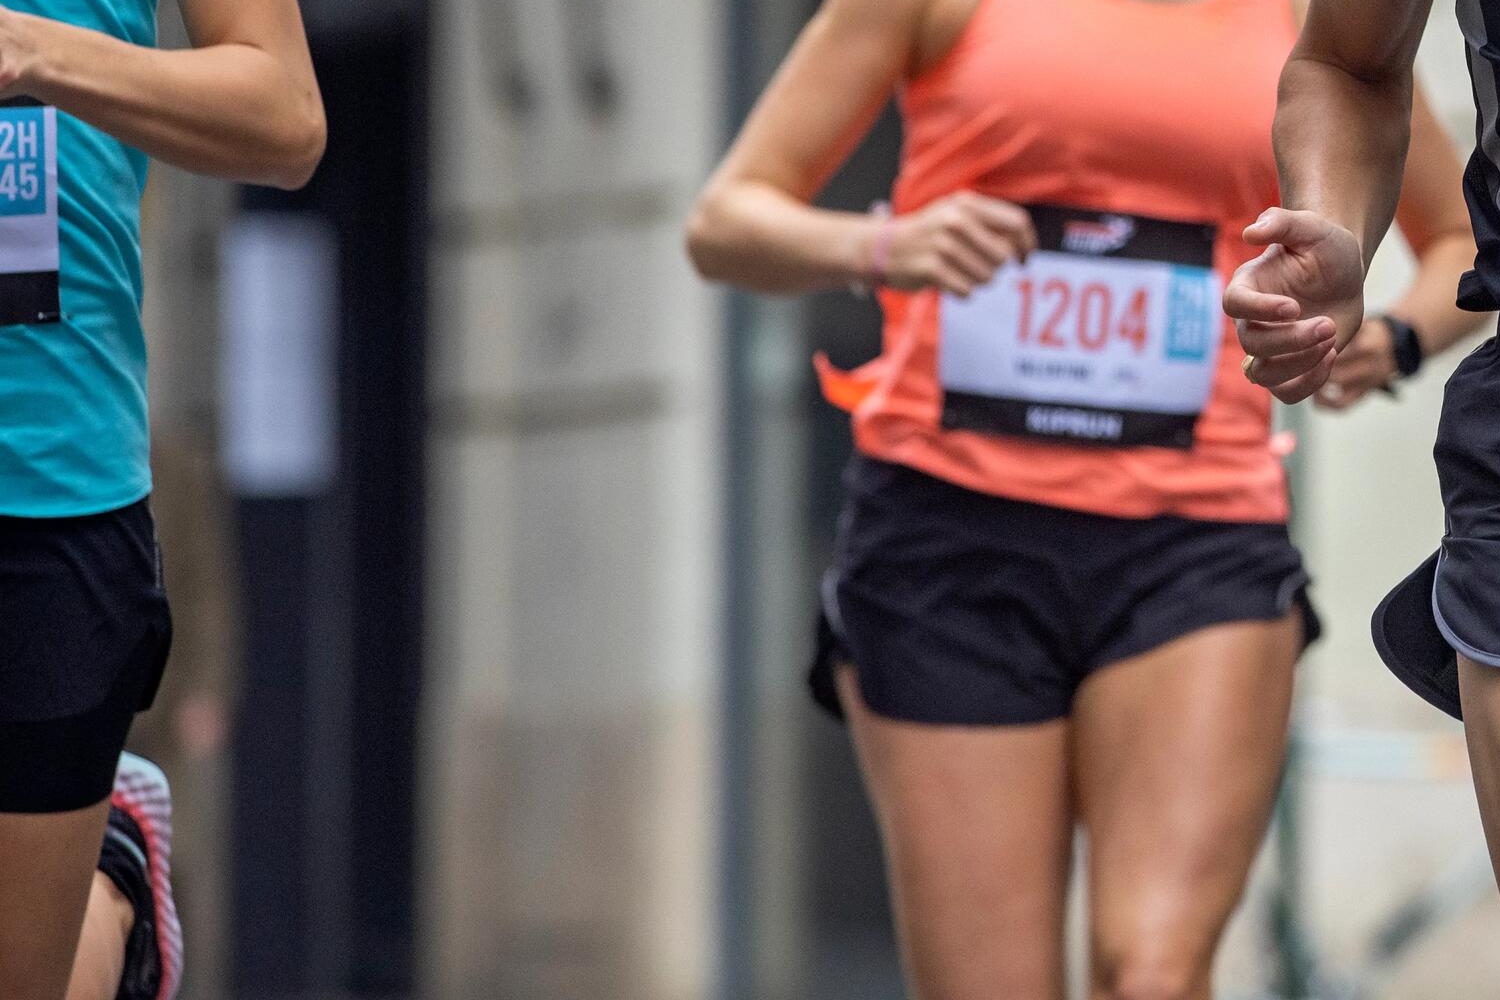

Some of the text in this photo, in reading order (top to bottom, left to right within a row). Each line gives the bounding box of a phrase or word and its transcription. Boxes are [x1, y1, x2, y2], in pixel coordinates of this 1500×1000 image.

[0, 121, 37, 160] 2H
[0, 163, 39, 200] 45
[1016, 277, 1149, 353] 1204
